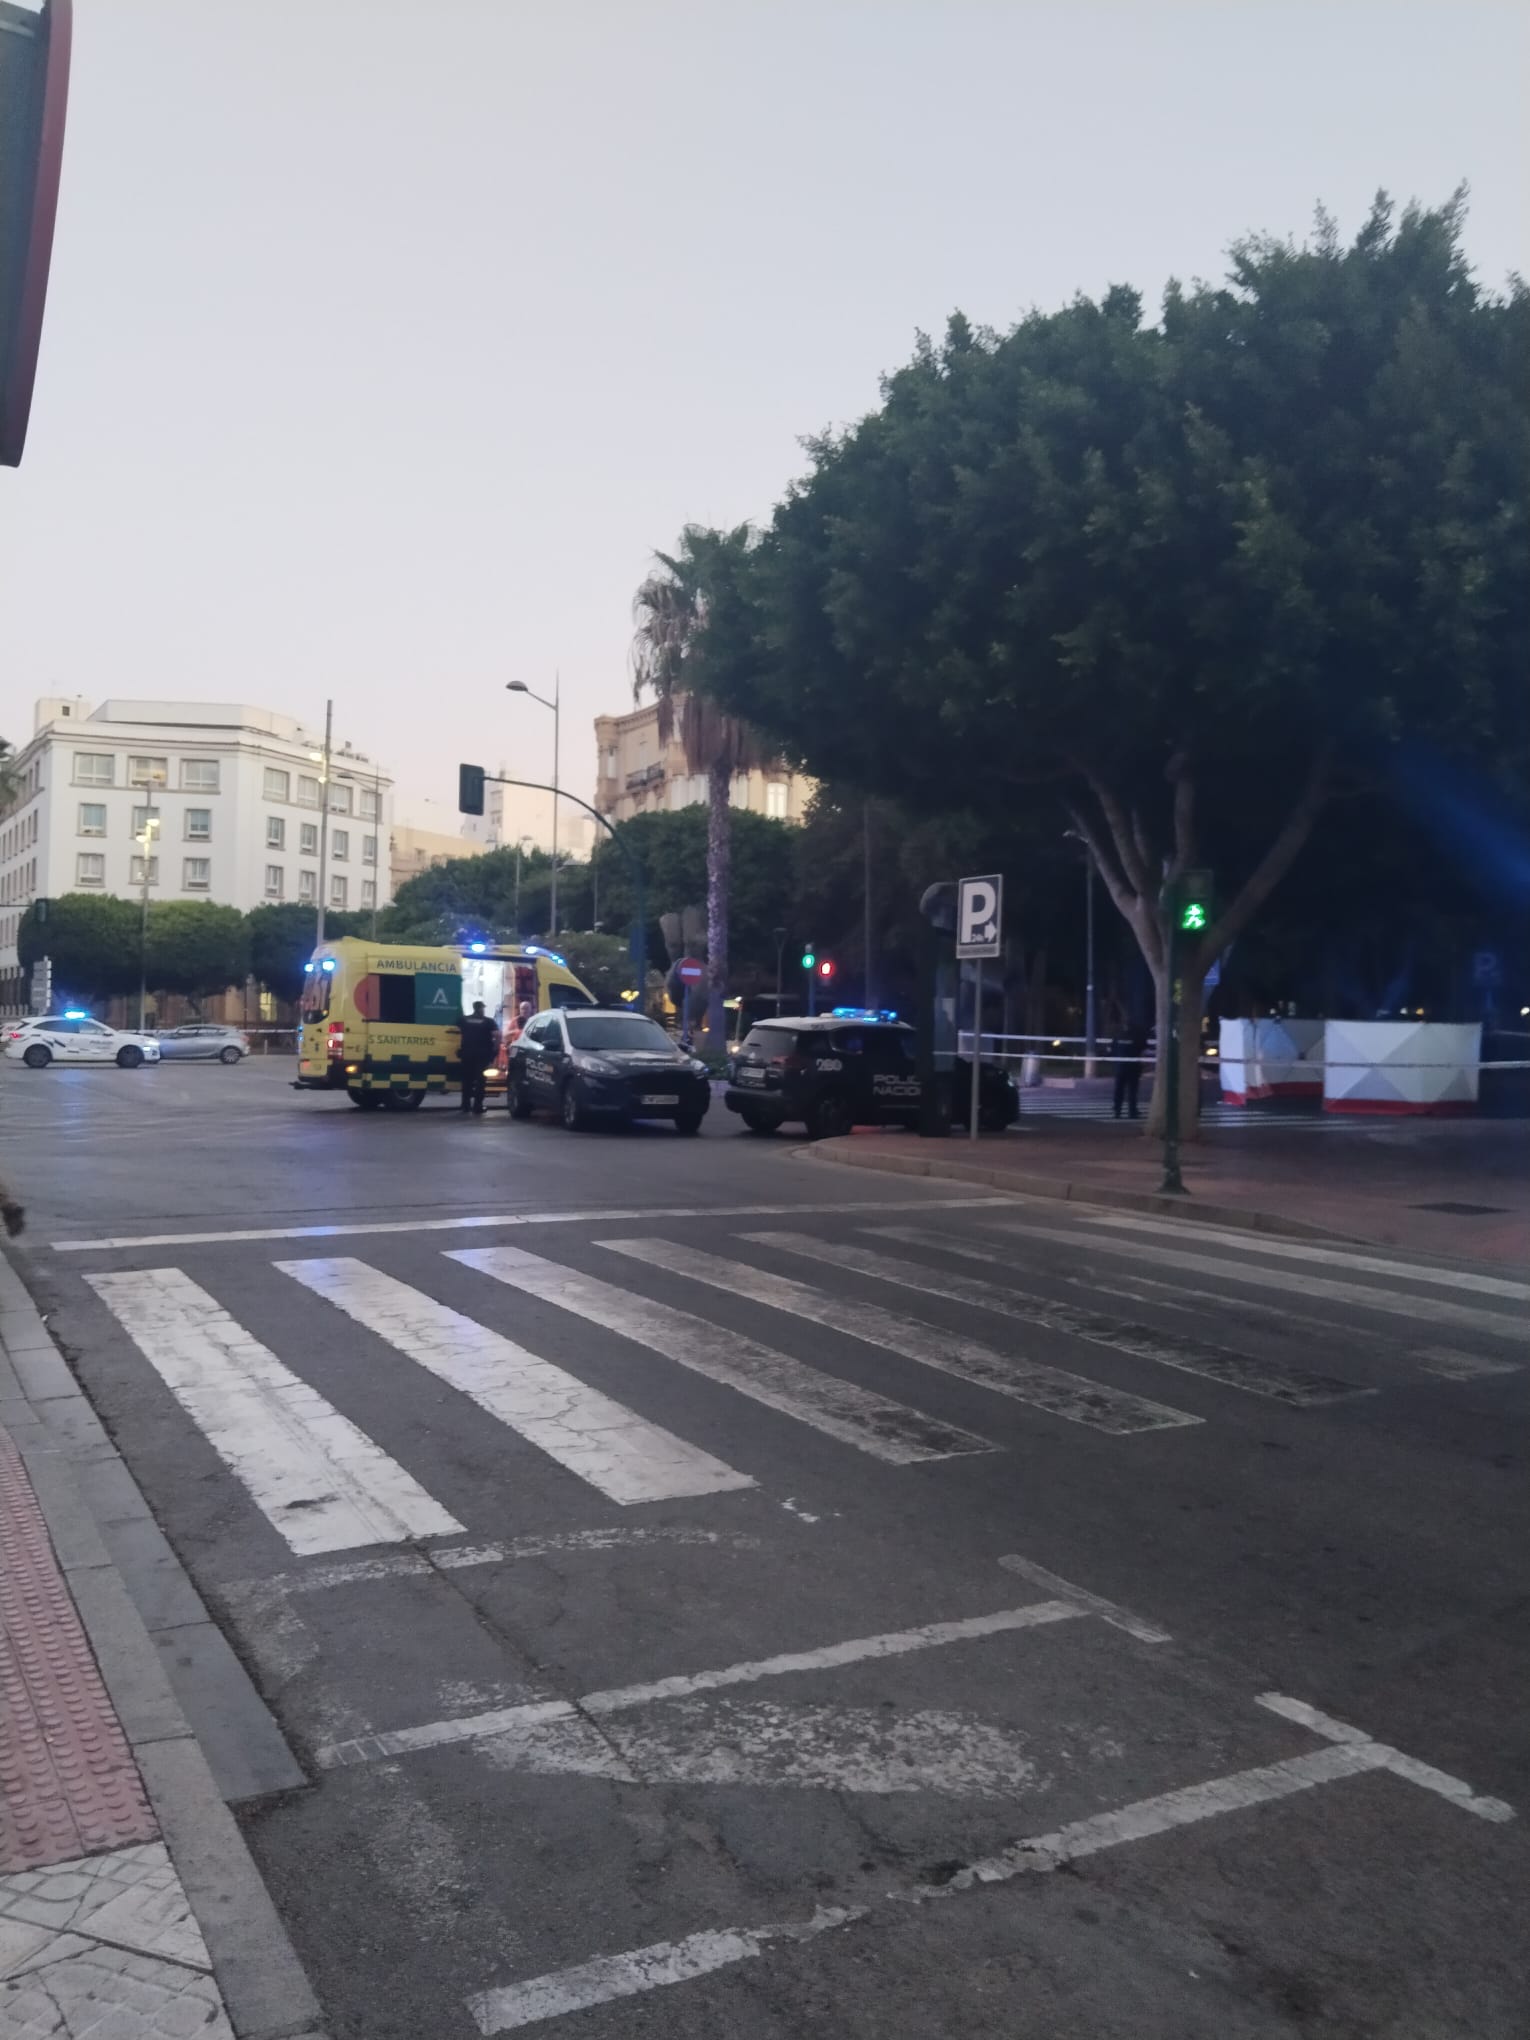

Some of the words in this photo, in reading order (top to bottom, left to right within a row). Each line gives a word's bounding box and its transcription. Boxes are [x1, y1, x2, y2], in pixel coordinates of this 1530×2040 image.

[961, 881, 996, 943] P
[376, 959, 457, 973] AMBULANCIA
[377, 1035, 436, 1047] SANITARIAS
[873, 1074, 921, 1086] POLIC
